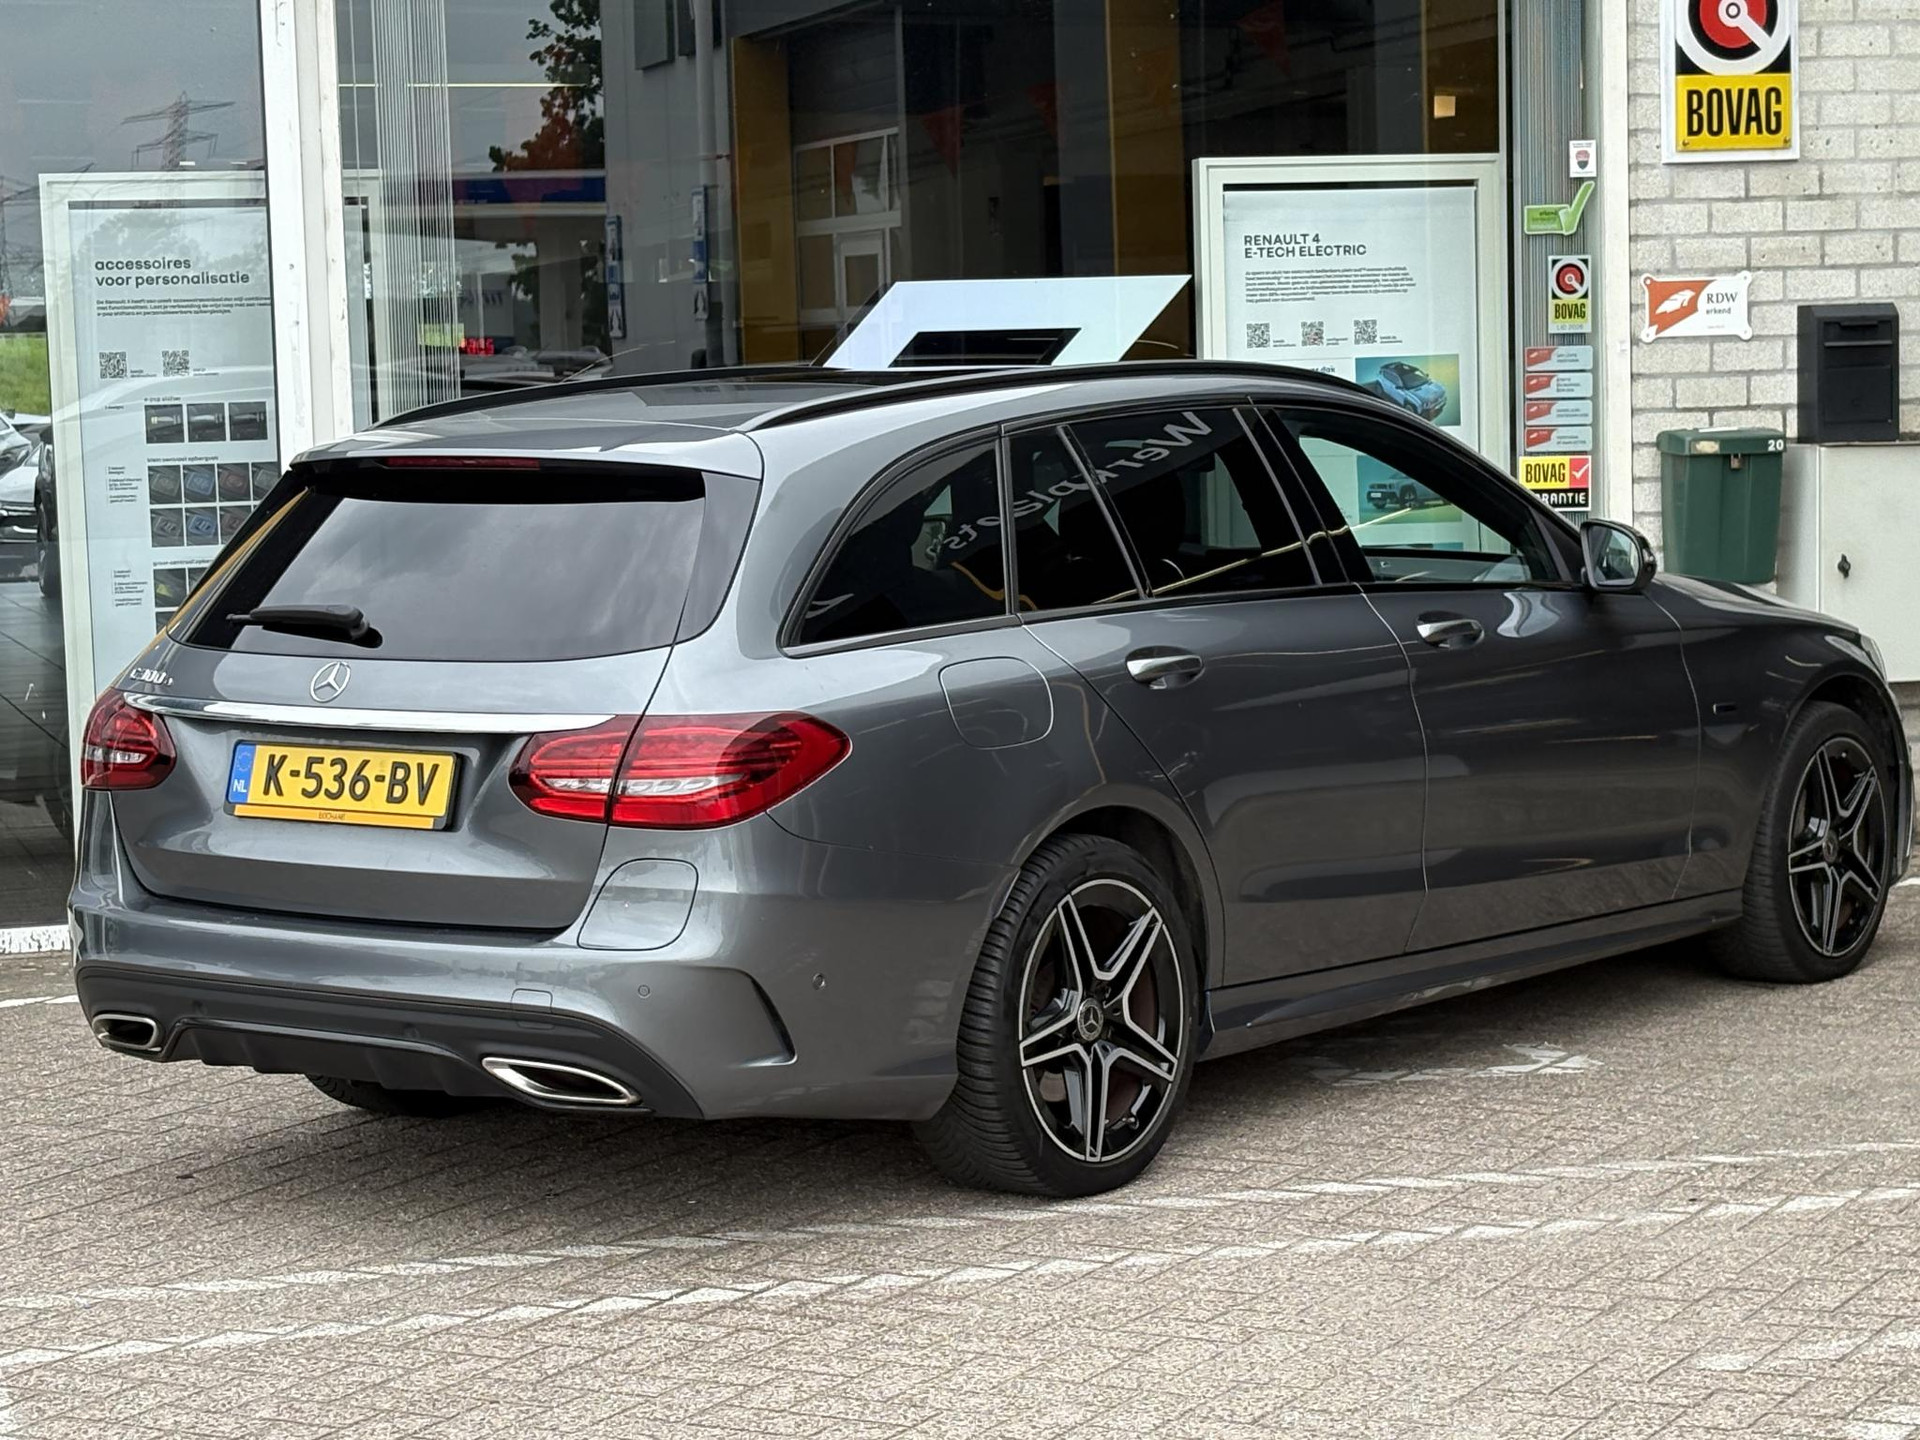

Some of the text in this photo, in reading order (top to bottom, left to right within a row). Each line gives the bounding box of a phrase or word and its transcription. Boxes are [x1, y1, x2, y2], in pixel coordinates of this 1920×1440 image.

[1686, 87, 1783, 137] BOVAG
[1244, 233, 1321, 246] RENAULT 4
[1244, 244, 1367, 259] E-TECH ELECTRIC
[95, 257, 192, 271] accessoires
[95, 271, 250, 289] voor personalisatie
[1706, 292, 1738, 304] RDW
[1554, 302, 1586, 320] BOVAG
[1706, 307, 1732, 315] erkend
[1767, 439, 1784, 452] 20
[1525, 462, 1566, 483] BOVAG
[232, 778, 248, 793] NL
[262, 752, 440, 806] K-536-BV
